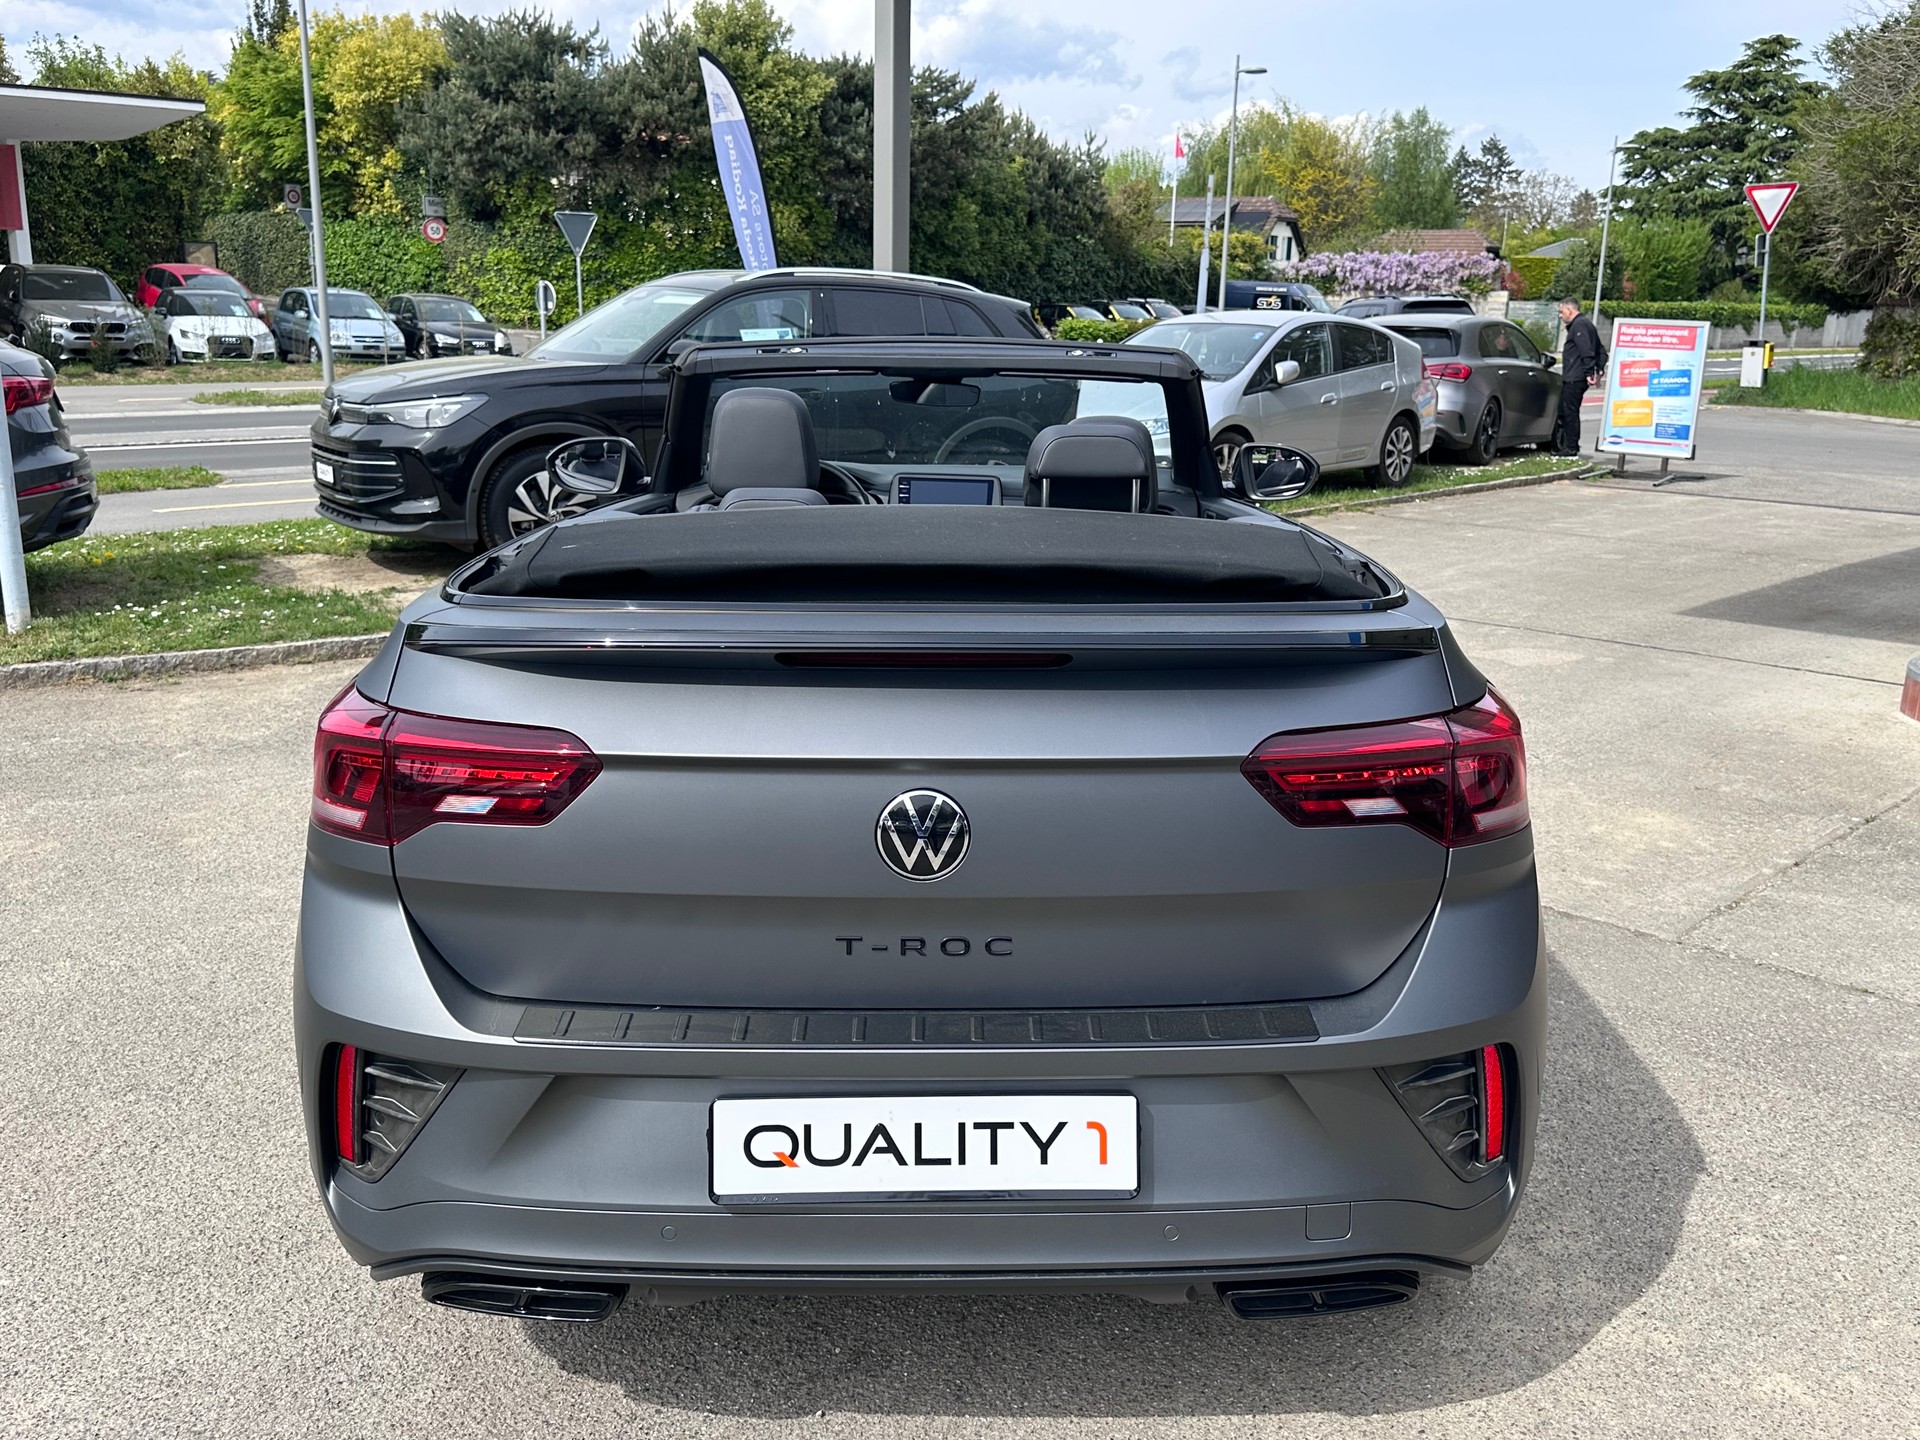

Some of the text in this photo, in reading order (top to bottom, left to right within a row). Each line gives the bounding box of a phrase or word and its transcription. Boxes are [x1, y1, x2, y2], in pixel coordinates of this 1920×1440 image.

[430, 226, 441, 236] 50
[1620, 326, 1689, 337] Rabais permanent
[1632, 335, 1661, 344] chaque
[835, 936, 1013, 957] T-ROC
[743, 1121, 1108, 1168] QUALITY 1
